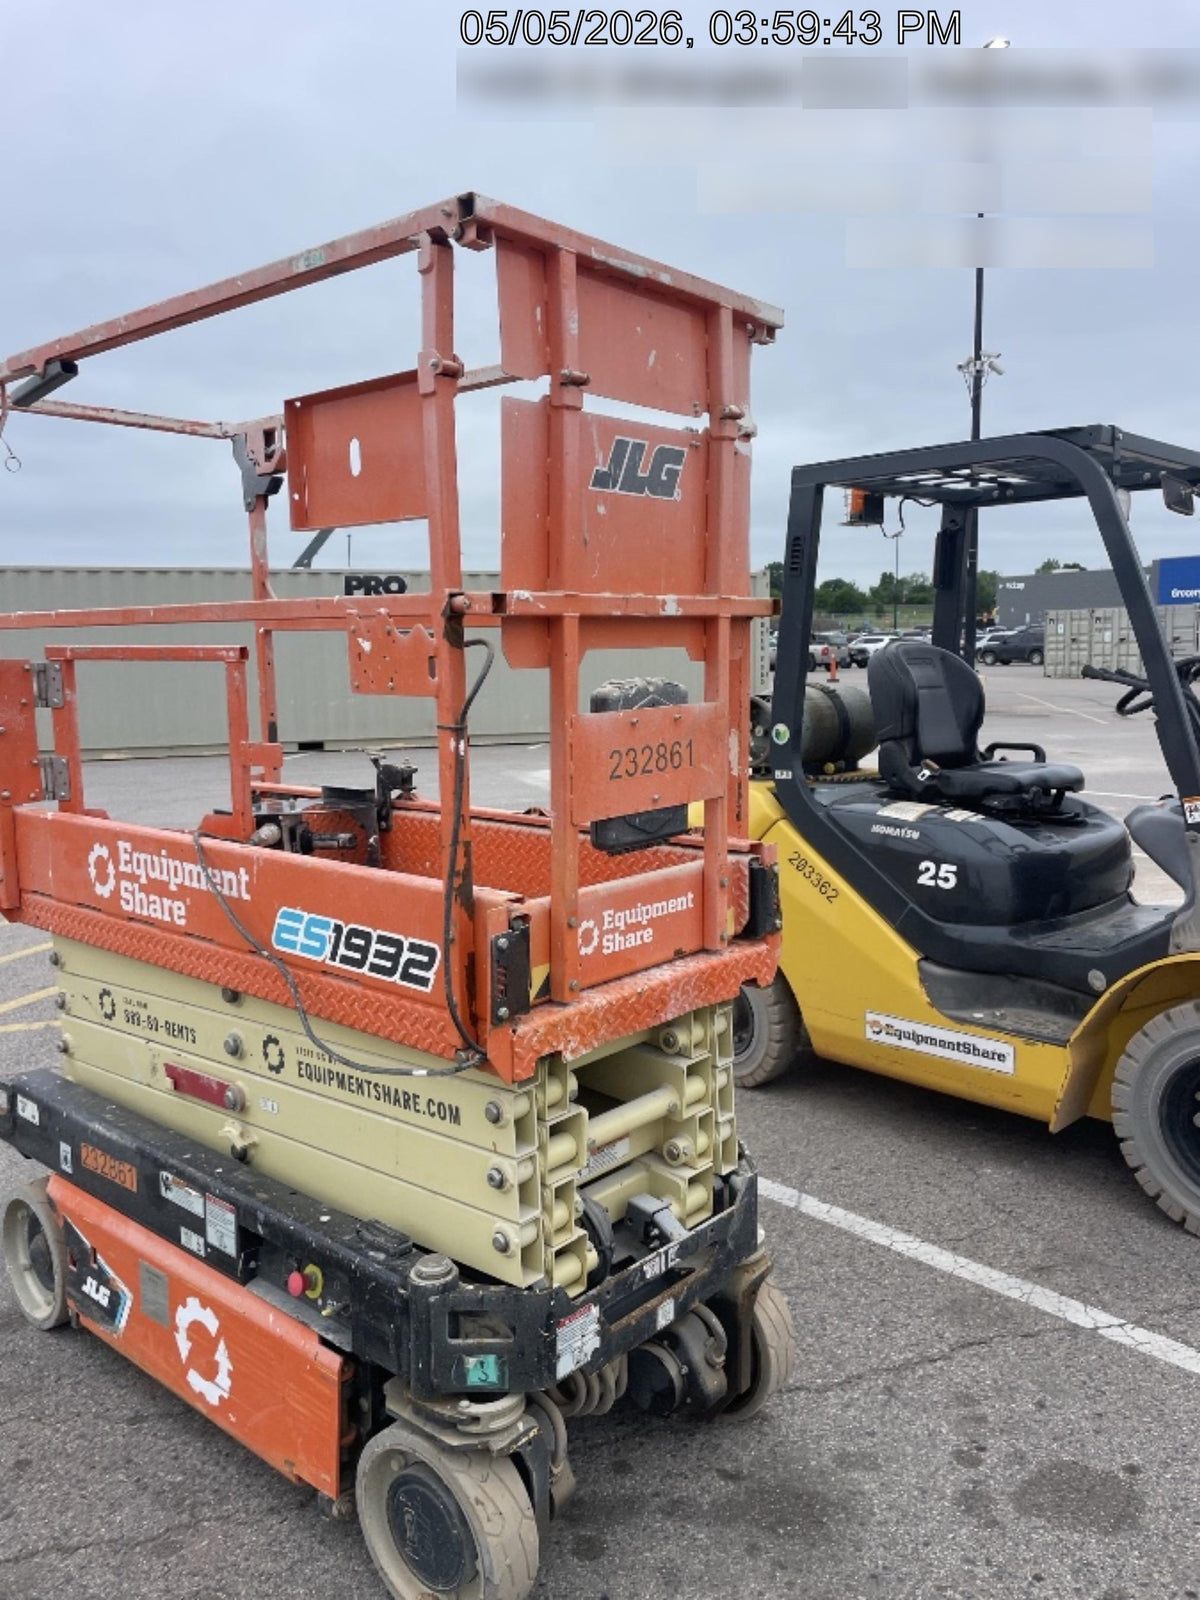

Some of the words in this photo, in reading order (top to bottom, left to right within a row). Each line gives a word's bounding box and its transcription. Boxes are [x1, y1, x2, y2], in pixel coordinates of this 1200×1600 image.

[588, 436, 688, 501] JLG
[344, 575, 407, 596] PRO
[609, 738, 694, 781] 232861
[871, 824, 921, 840] KOMATSU
[117, 840, 251, 901] Equipment
[788, 850, 840, 905] 203362
[917, 860, 958, 890] 25
[120, 879, 187, 926] Share
[602, 891, 695, 930] Equipment
[273, 907, 441, 991] ES1932
[602, 927, 654, 956] Share
[884, 1023, 1008, 1063] EquipmentShare
[296, 1060, 462, 1126] EQUIPMENTSHARE.COM
[81, 1143, 136, 1190] 232861
[81, 1275, 111, 1308] JLG
